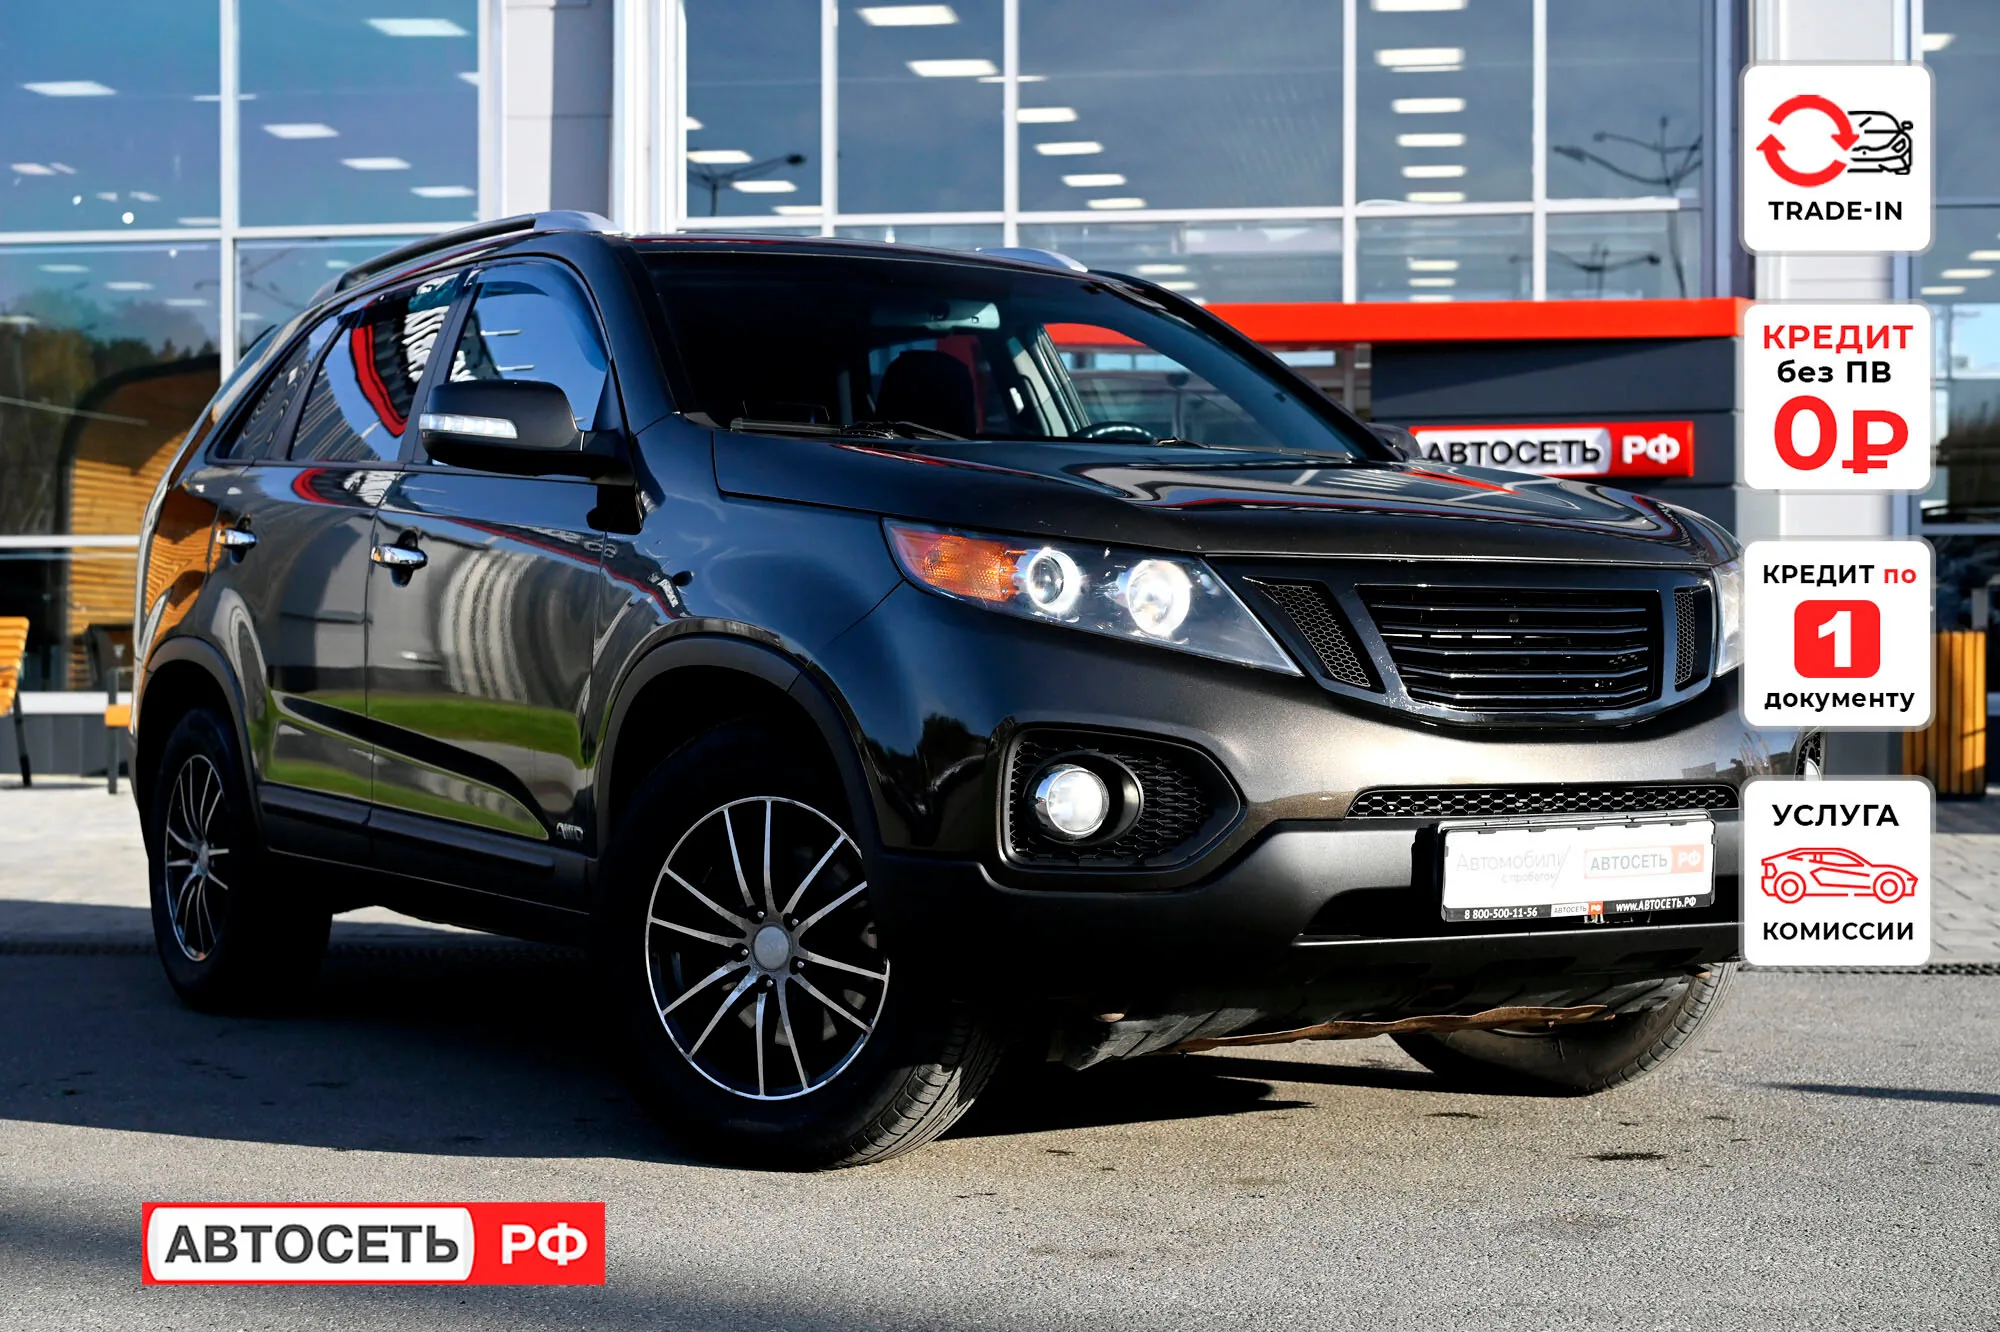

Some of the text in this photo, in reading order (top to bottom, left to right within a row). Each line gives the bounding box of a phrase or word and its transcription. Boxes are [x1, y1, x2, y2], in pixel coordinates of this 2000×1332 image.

[1426, 433, 1681, 465] АВТОСЕТЬ РФ
[1590, 849, 1701, 871] АВТОСЕТЬ РФ
[1553, 903, 1602, 914] АВТОСЕТЬ РФ
[1615, 896, 1697, 912] www.АВТОСЕТЬ.РФ
[1464, 907, 1538, 919] 8 800-500-11-56
